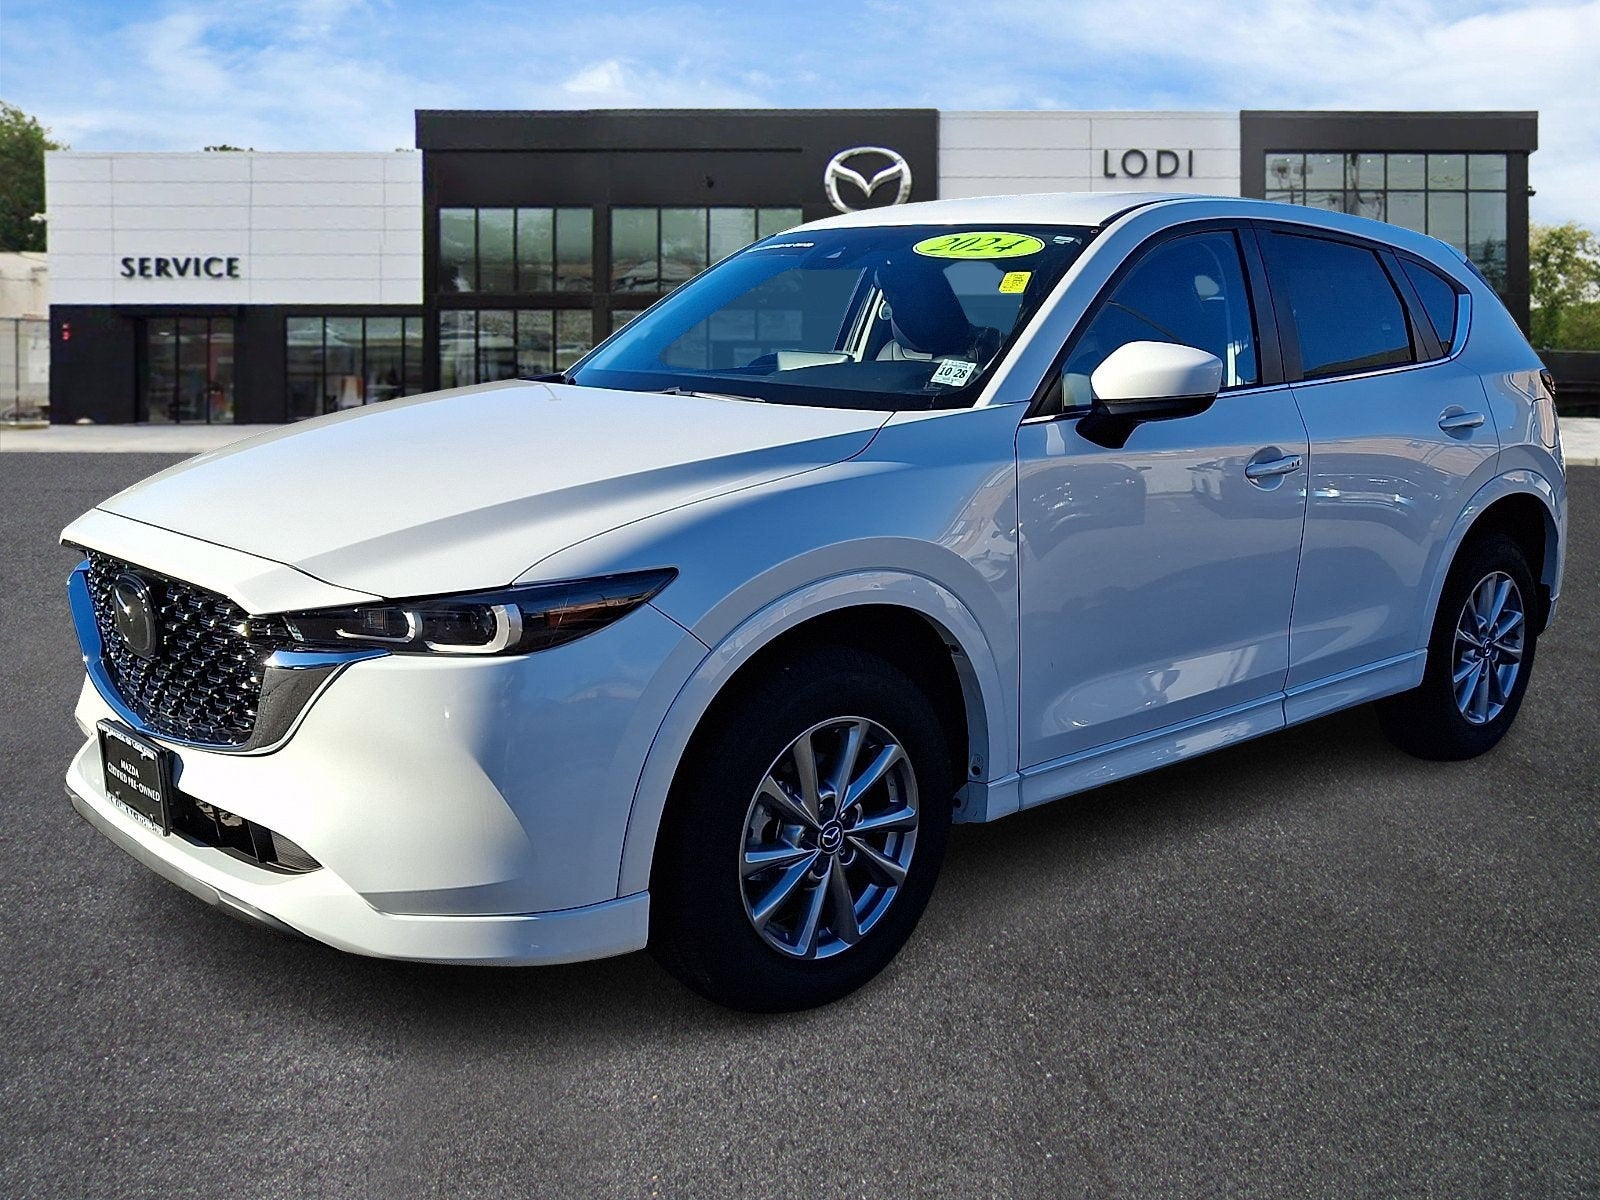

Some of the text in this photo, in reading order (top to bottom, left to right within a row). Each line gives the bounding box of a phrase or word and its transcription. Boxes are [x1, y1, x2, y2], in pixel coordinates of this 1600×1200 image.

[1103, 148, 1193, 178] LODI
[926, 237, 1030, 252] 2024
[120, 257, 240, 278] SERVICE
[938, 366, 968, 379] 10 28
[120, 759, 140, 779] MAZDA
[107, 761, 161, 802] CERTIFIED PRE-OWNED
